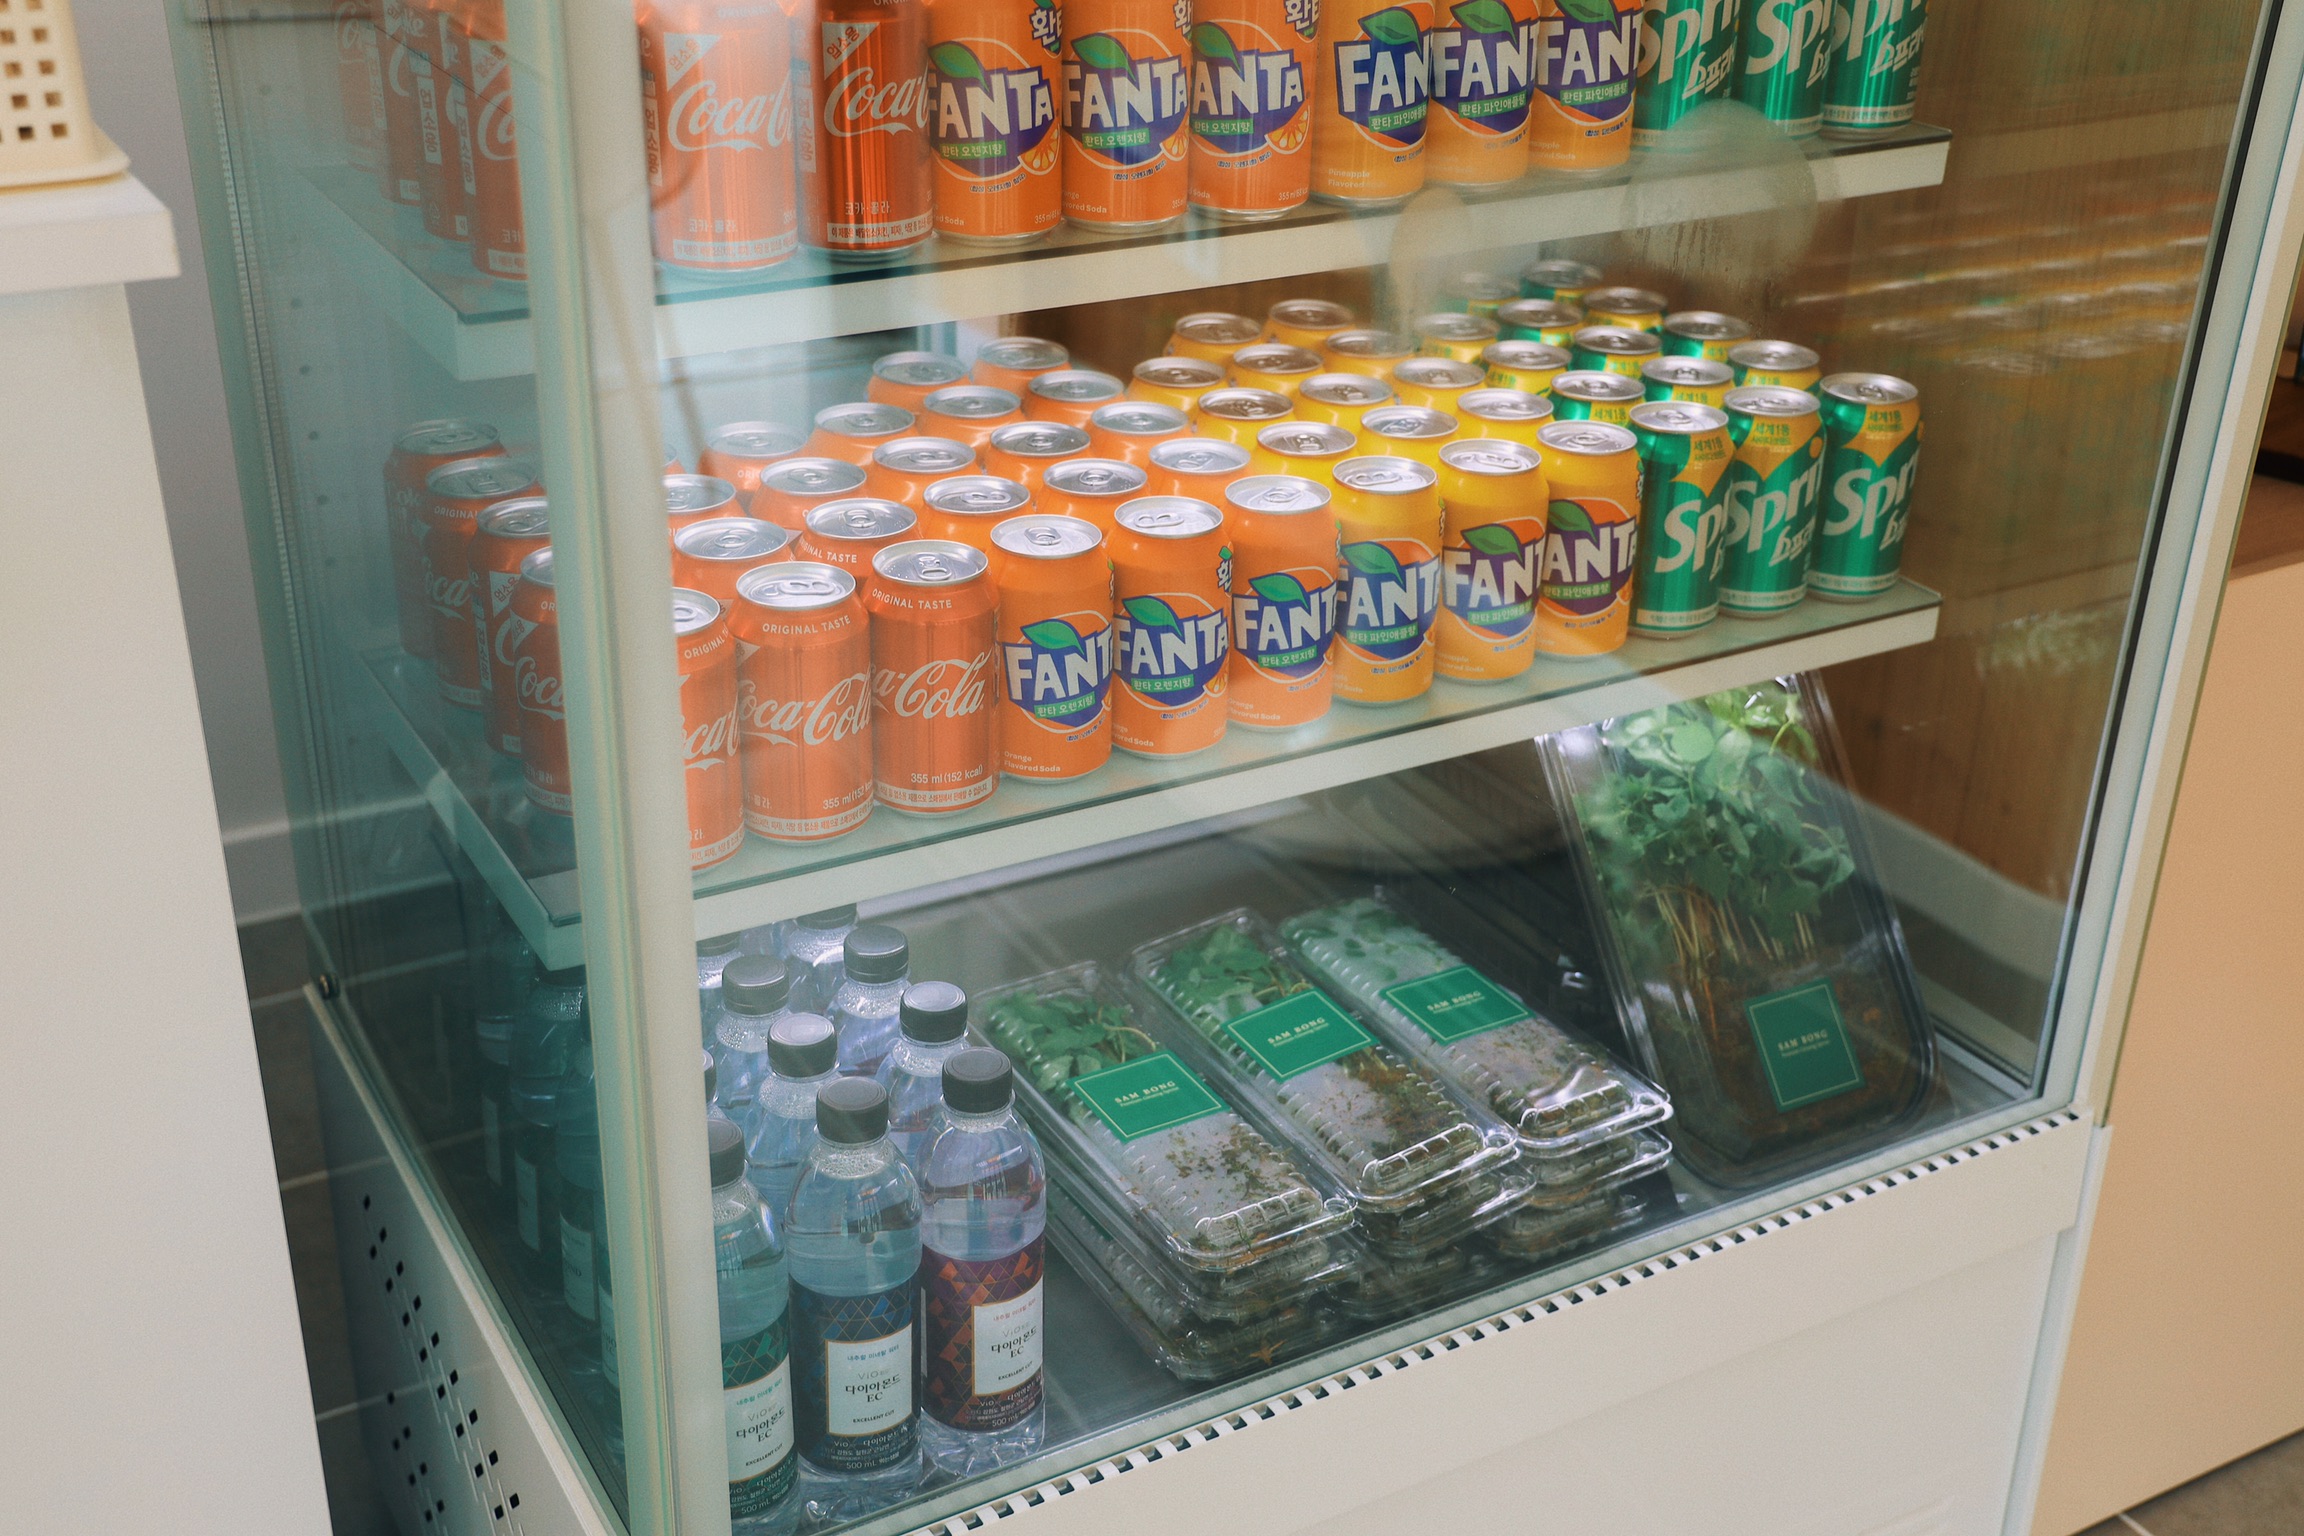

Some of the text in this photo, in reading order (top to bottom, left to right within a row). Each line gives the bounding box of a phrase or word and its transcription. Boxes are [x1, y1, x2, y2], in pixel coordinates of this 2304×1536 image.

[827, 26, 860, 60] 업소용
[668, 38, 699, 71] 업소용
[1062, 59, 1187, 128] FANTA
[1562, 91, 1582, 103] 환타
[1461, 100, 1481, 115] 환타
[1211, 120, 1250, 133] 오렌지향
[1371, 117, 1391, 131] 환타
[1085, 131, 1147, 148] 환타 오렌지향
[942, 142, 1002, 157] 환타 오렌지향
[1328, 168, 1370, 178] Pineapple
[1328, 179, 1365, 188] Flavored
[1086, 204, 1107, 213] Soda
[944, 216, 965, 226] Soda
[1755, 422, 1791, 437] 세계1등
[1693, 436, 1723, 451] 세계1등
[826, 551, 857, 563] TASTE
[872, 588, 953, 610] ORIGINAL TASTE
[1232, 582, 1337, 651] FANT
[762, 615, 851, 635] ORIGINAL TASTE
[684, 637, 725, 660] ORIGINAL
[1113, 611, 1229, 676] FANTA
[1004, 626, 1112, 701] FANT
[1260, 647, 1315, 667] 환타 오렌지향
[1134, 676, 1191, 691] 환타 오렌지향
[1037, 695, 1093, 717] 환타 오렌지향
[1134, 738, 1154, 747] Soda
[1004, 751, 1032, 763] Orange
[911, 772, 929, 784] 355
[964, 763, 983, 780] kcal)
[1004, 759, 1061, 773] Flavored Soda
[823, 797, 840, 810] 355
[1427, 1000, 1449, 1011] SAM
[1267, 1030, 1291, 1044] SAM
[1294, 1017, 1325, 1033] BONG
[1778, 1038, 1798, 1051] SAM
[1114, 1091, 1139, 1104] SAM
[1143, 1080, 1176, 1095] BONG
[991, 1326, 1037, 1353] 다이아몬드
[847, 1353, 866, 1361] 내추럴
[868, 1349, 887, 1359] 미네랄
[1010, 1346, 1024, 1358] EC
[858, 1370, 879, 1380] ViO
[998, 1366, 1024, 1381] EXCELLENT
[845, 1374, 901, 1395] 다이아몬드
[866, 1391, 883, 1402] EC
[736, 1406, 785, 1439] 다이아몬드
[853, 1409, 895, 1423] EXCELLENT CUT
[992, 1417, 1007, 1427] 500
[757, 1428, 772, 1443] EC
[863, 1431, 898, 1447] 다이아몬드
[745, 1449, 774, 1467] EXCELLENT
[846, 1461, 862, 1469] 500
[741, 1503, 757, 1514] 500
